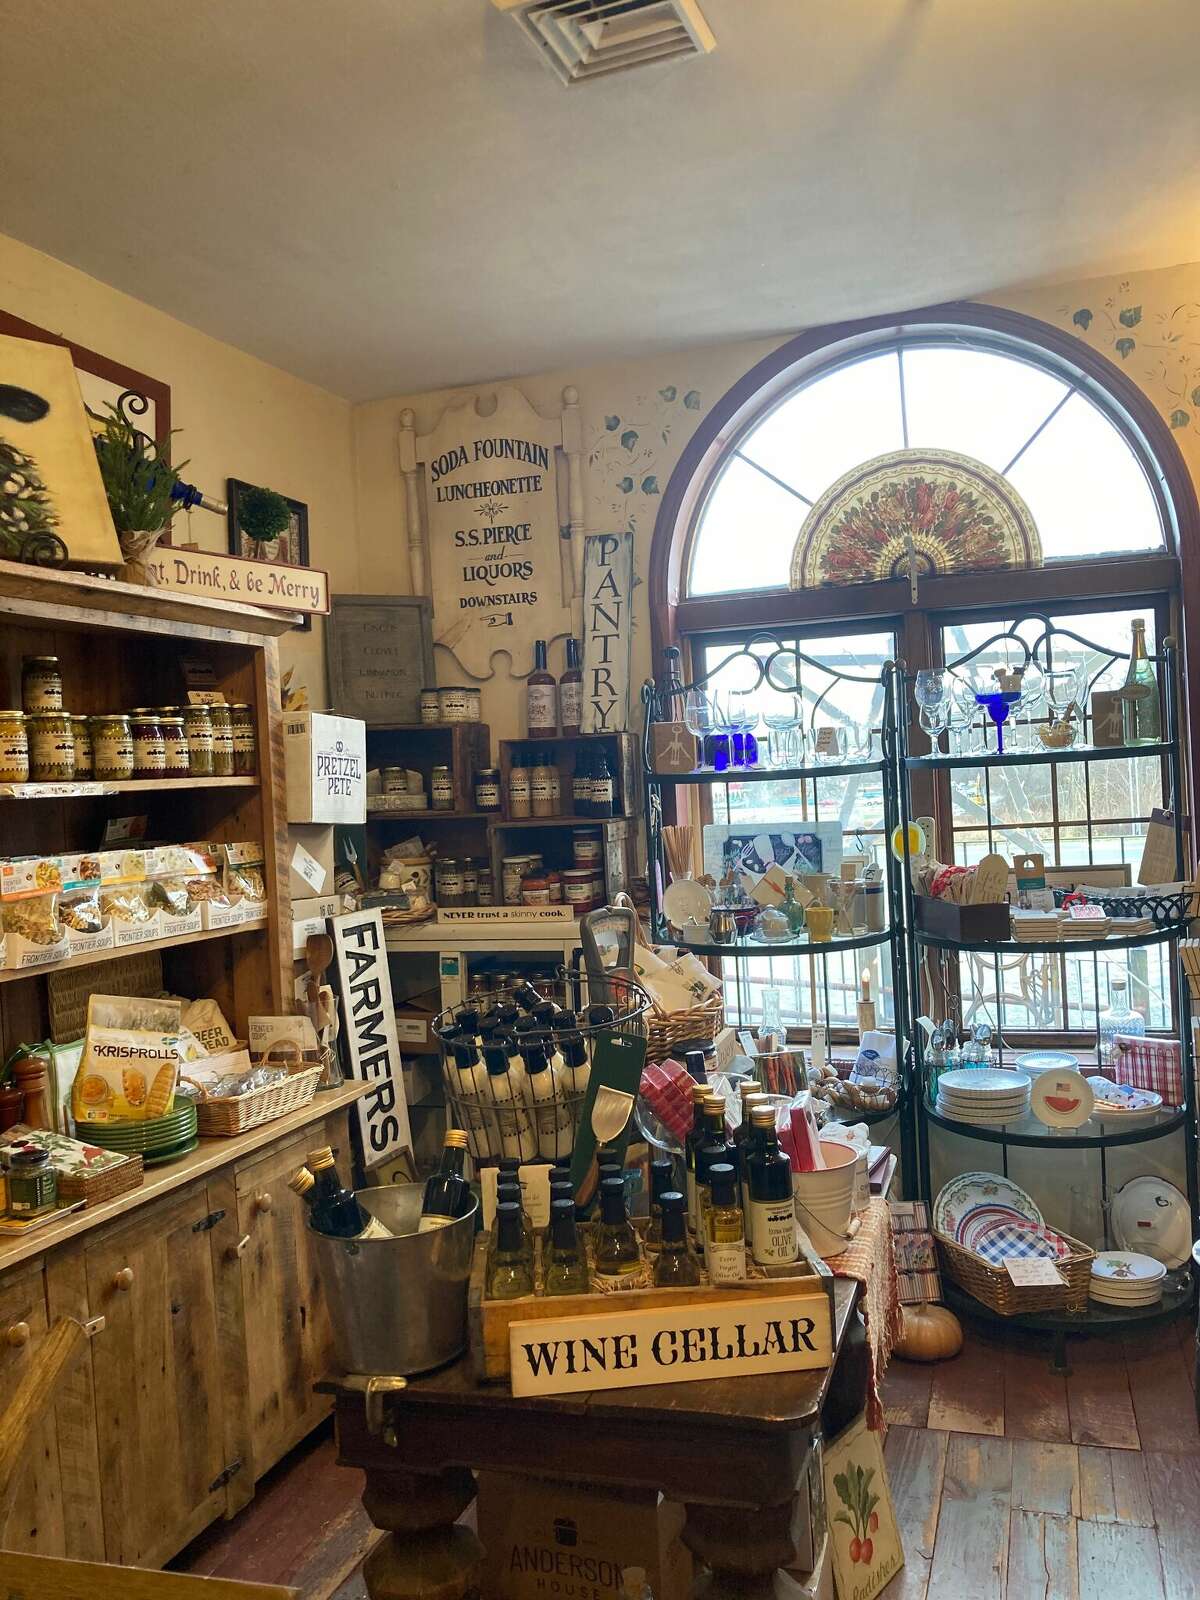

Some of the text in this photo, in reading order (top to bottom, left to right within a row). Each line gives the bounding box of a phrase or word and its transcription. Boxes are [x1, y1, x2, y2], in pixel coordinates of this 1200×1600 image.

[431, 438, 550, 483] SODA FOUNTAIN
[436, 475, 543, 502] LUNCHEONETTE
[484, 545, 505, 561] and
[174, 559, 226, 591] Drink,
[229, 569, 241, 590] &
[246, 571, 263, 592] be
[267, 573, 319, 608] Merry
[463, 561, 534, 586] LIQUORS
[459, 591, 538, 609] DOWNSTAIRS
[590, 536, 623, 730] PANTRY
[317, 755, 361, 779] PRETZEL
[328, 777, 352, 796] PETE
[443, 911, 474, 919] NEVER
[511, 910, 538, 918] skinny
[539, 910, 566, 918] cook.
[69, 936, 113, 952] FRONTIER SOUPS
[118, 928, 159, 943] FRONTIER SOUPS
[21, 947, 70, 965] FRONTIER SOUPS
[342, 921, 399, 1152] FARMERS
[93, 1045, 179, 1060] KRISPROLLS
[521, 1317, 819, 1377] WINE CELLAR
[510, 1544, 627, 1591] ANDERSON
[536, 1578, 600, 1600] HOUSE
